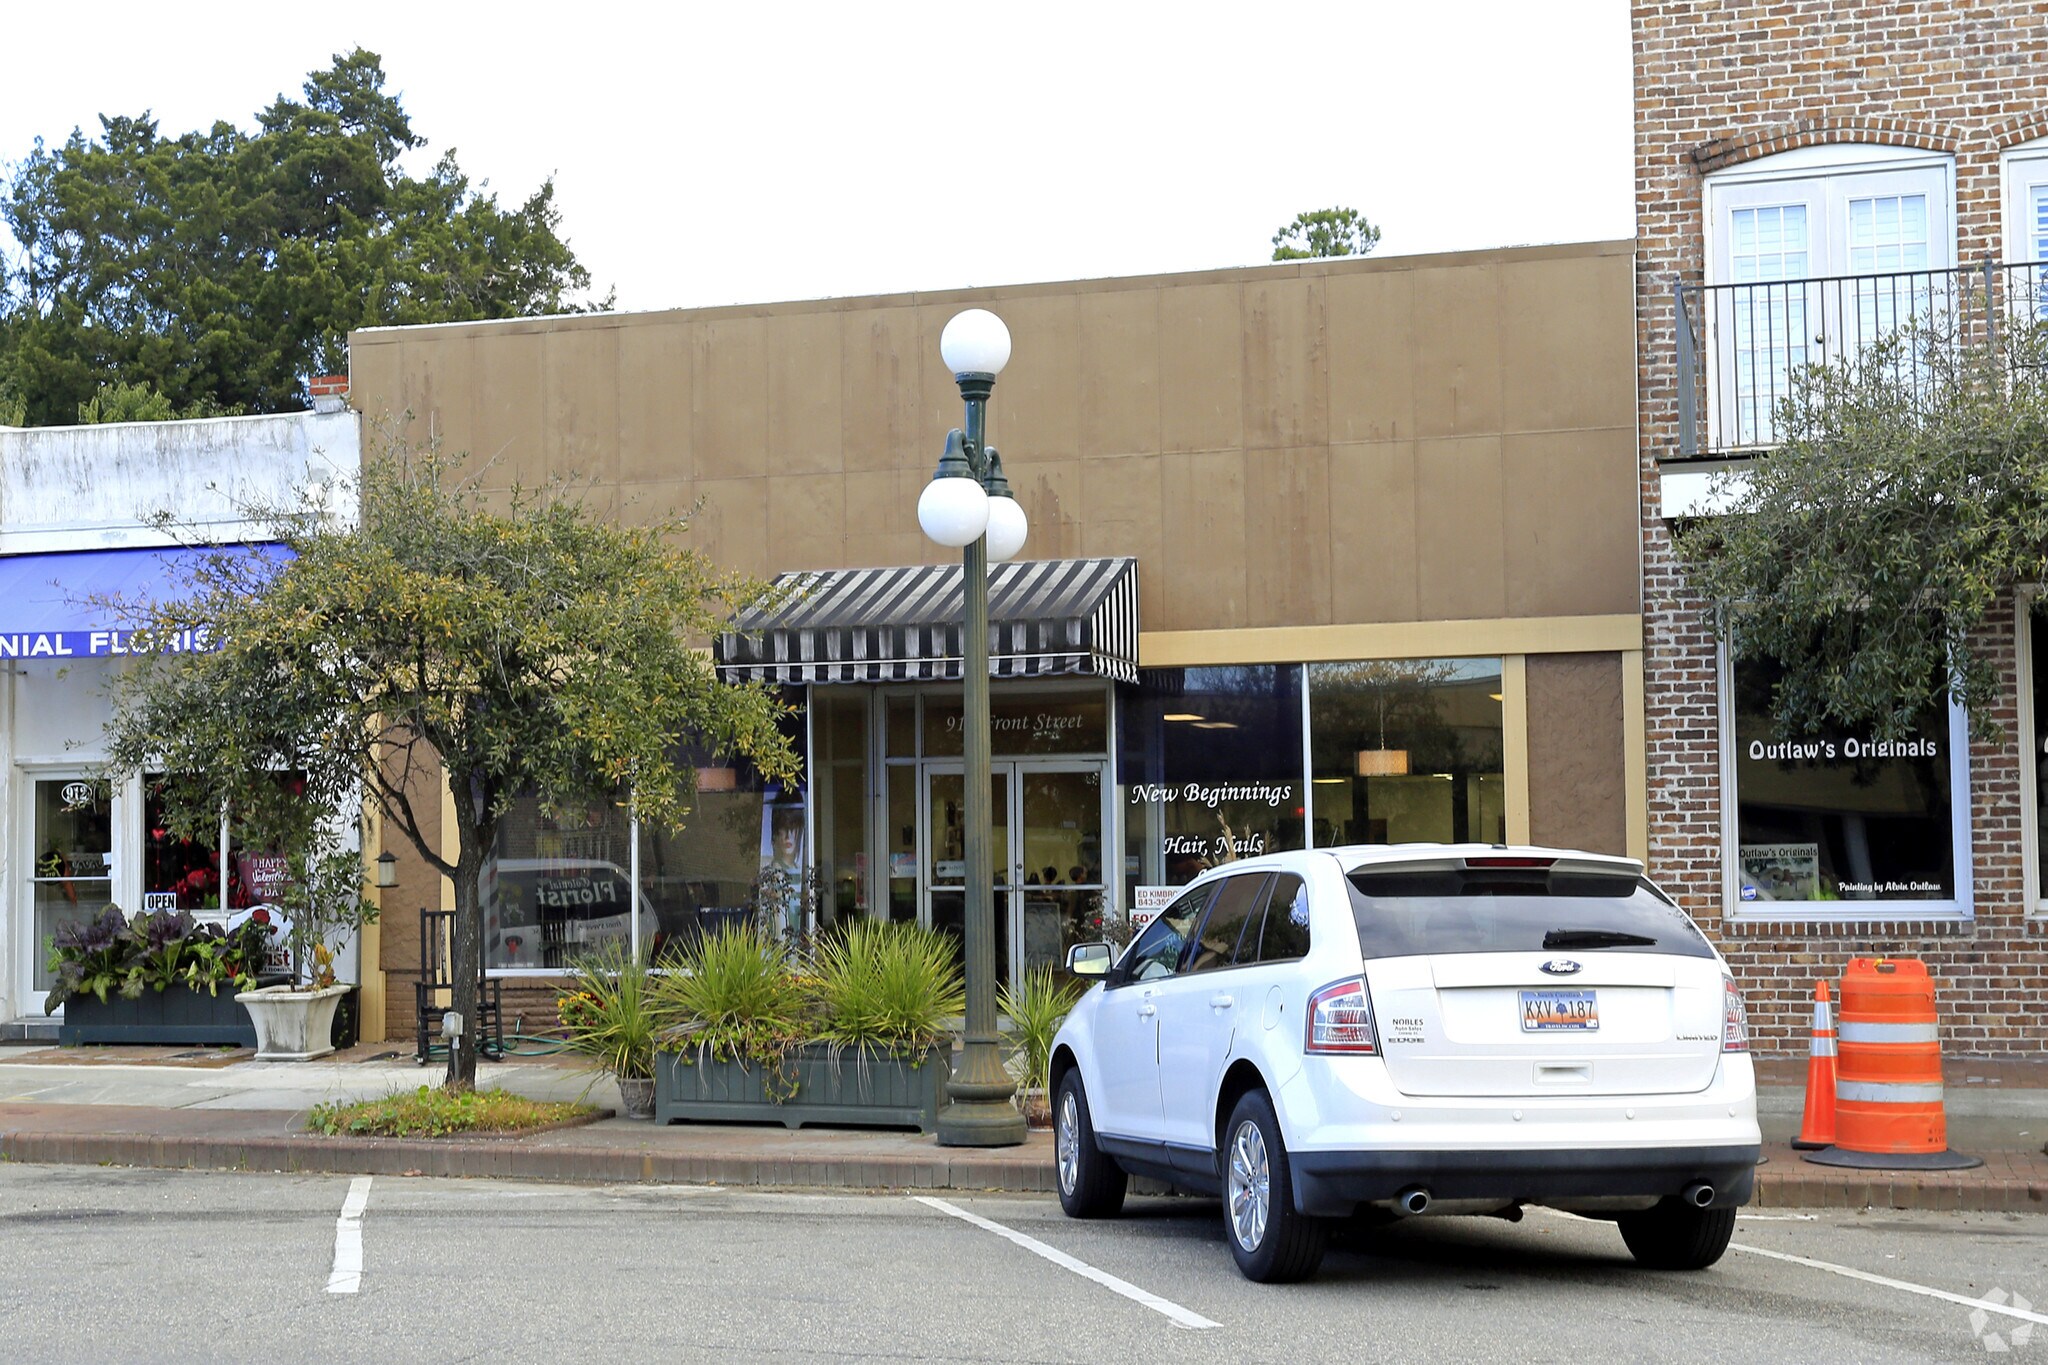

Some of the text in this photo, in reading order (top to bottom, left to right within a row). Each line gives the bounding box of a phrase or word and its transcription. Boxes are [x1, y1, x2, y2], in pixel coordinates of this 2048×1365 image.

[1033, 713, 1083, 730] Street
[1749, 737, 1936, 760] Outlaw's Originals
[66, 786, 88, 801] 912
[1131, 780, 1292, 808] New Beginnings
[1163, 833, 1265, 856] Hair, Nails
[1739, 847, 1817, 858] Outlaw's Originals
[1838, 881, 1942, 893] Painting by Alvin Outlaw
[148, 894, 175, 909] OPEN
[1525, 1000, 1593, 1019] KXV 187
[1392, 1018, 1424, 1026] NOBLES
